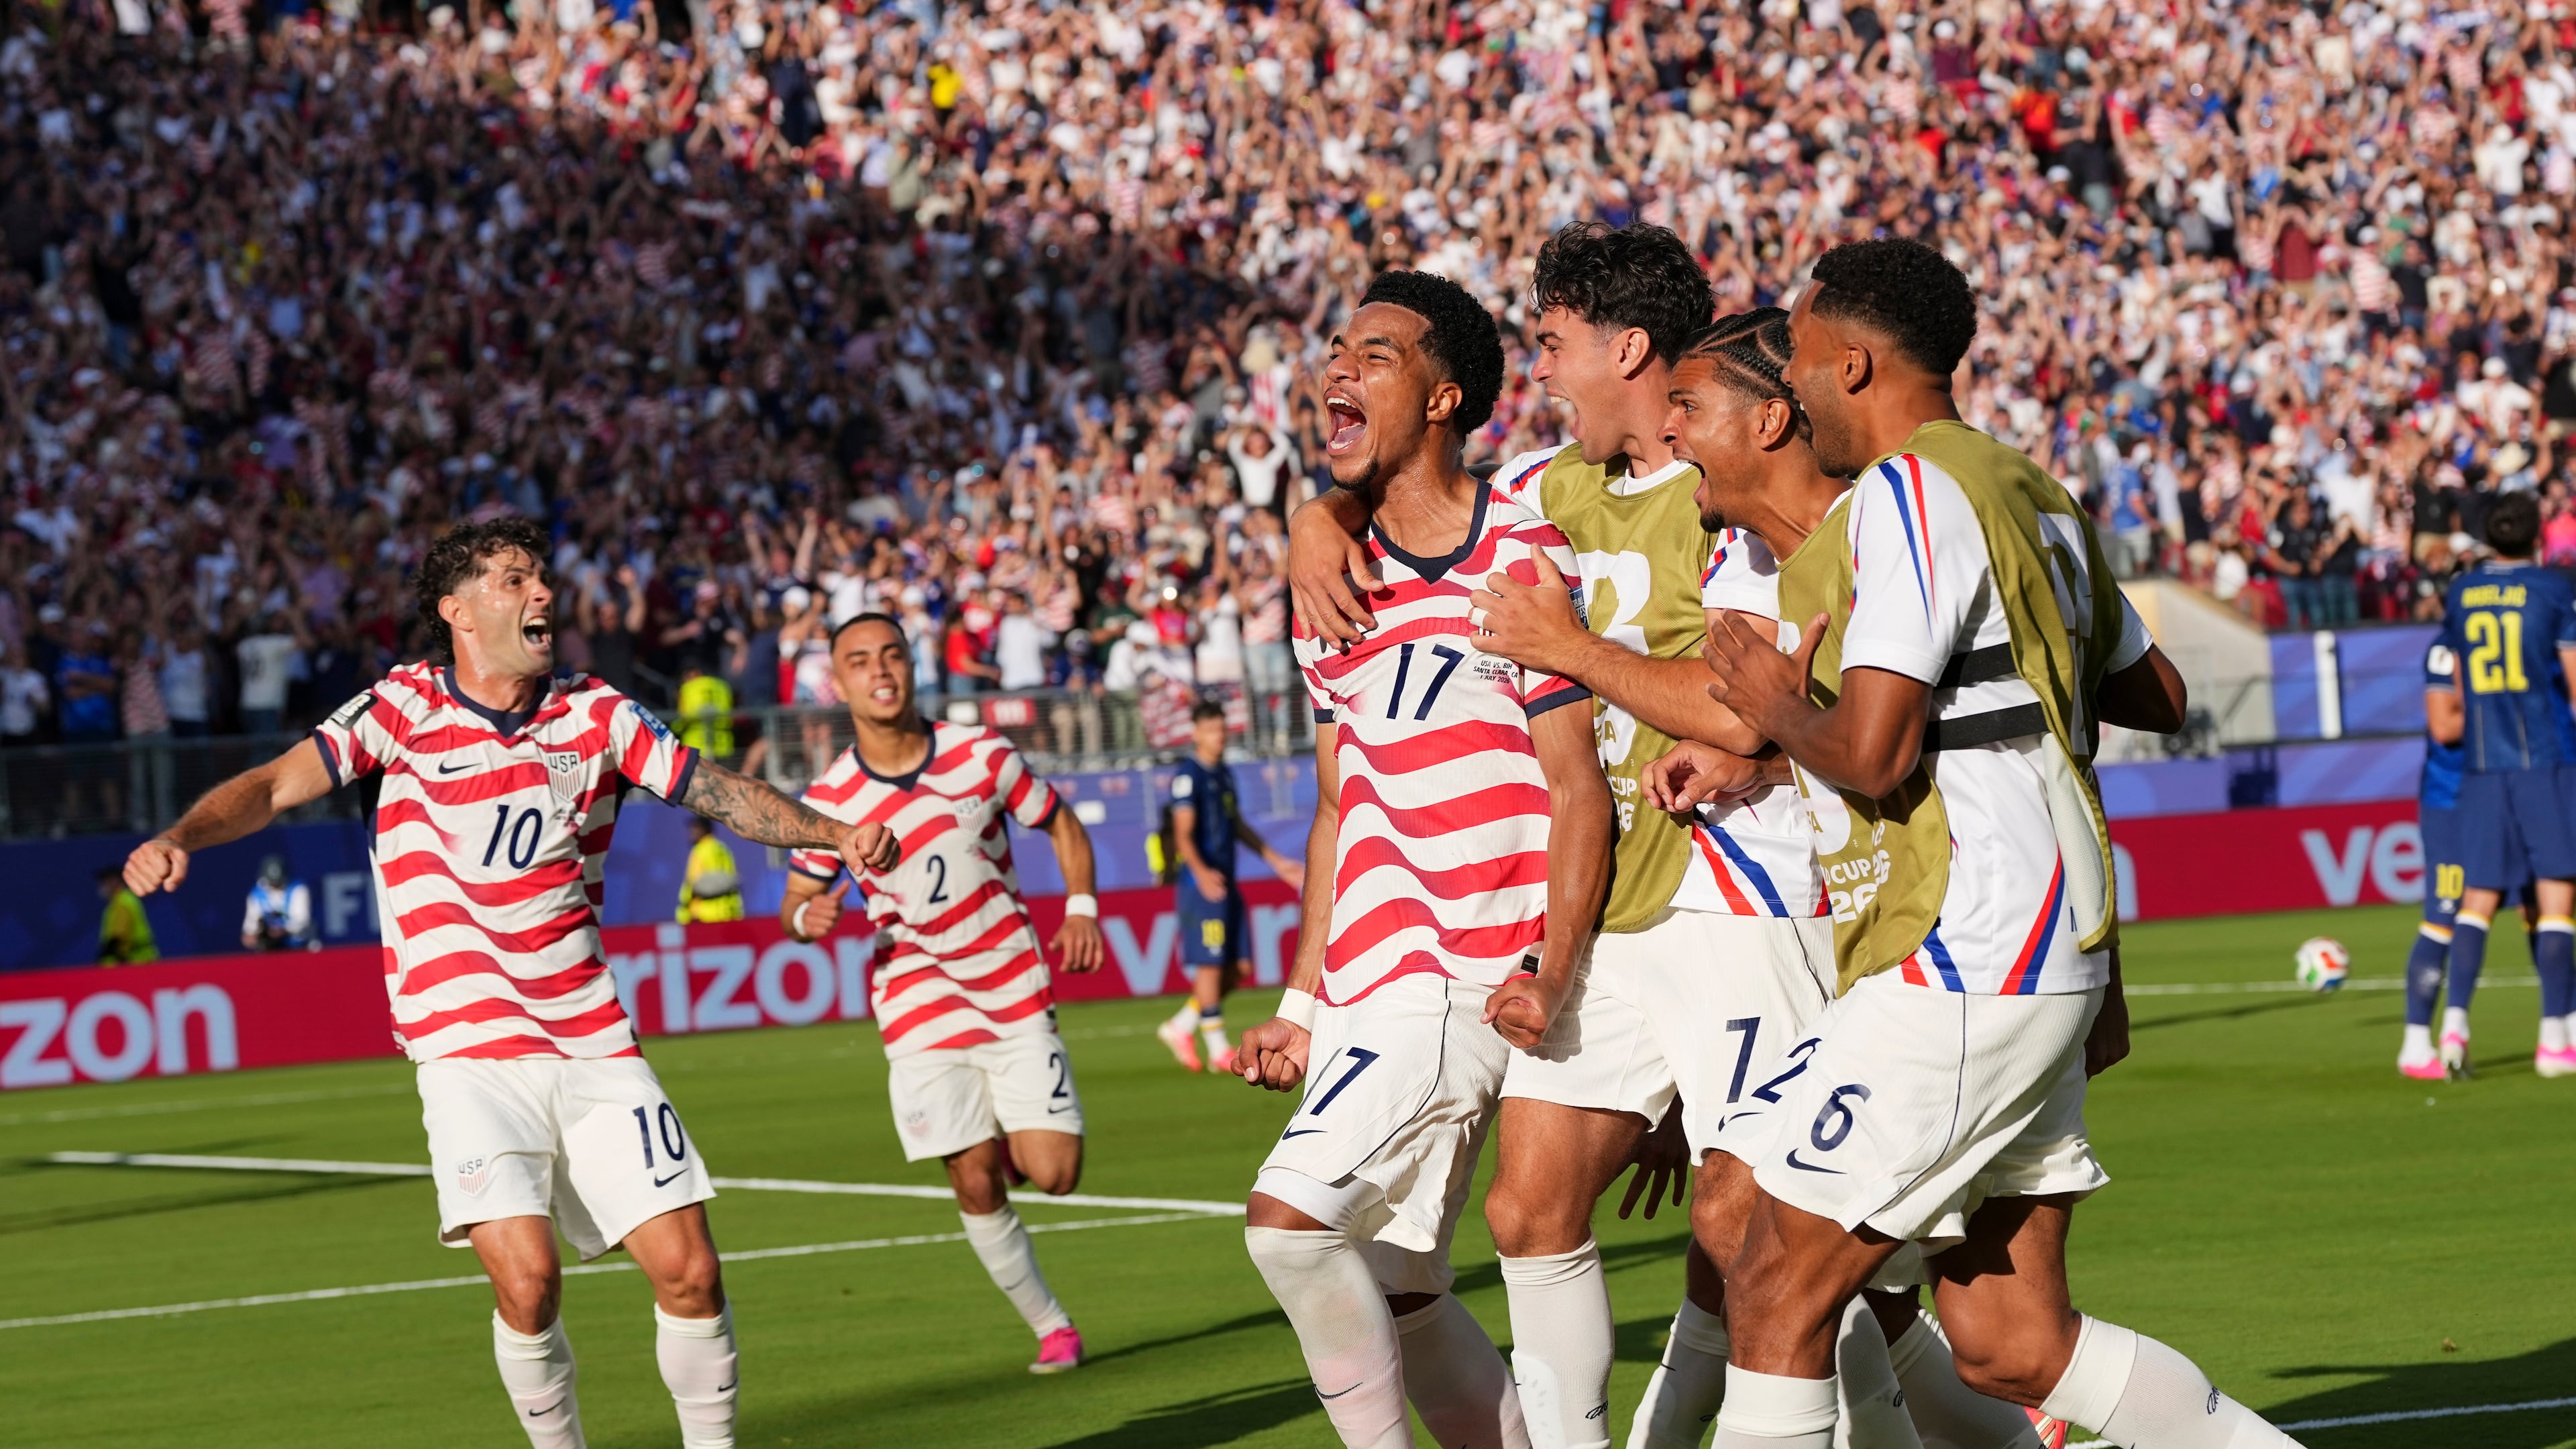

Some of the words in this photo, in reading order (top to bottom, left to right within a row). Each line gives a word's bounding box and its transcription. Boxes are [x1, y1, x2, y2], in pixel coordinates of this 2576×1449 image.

[1473, 666, 1490, 674] SANTA
[2465, 611, 2528, 694] 21
[1386, 643, 1465, 721] 17
[549, 755, 577, 773] USA
[1611, 775, 1637, 797] CUP
[482, 804, 543, 870] 10
[927, 855, 949, 904] 2
[1830, 859, 1872, 883] CUP
[2435, 863, 2465, 900] 10
[1829, 883, 1878, 924] 26
[0, 983, 238, 1089] zon
[1726, 1016, 1761, 1104] 7
[1049, 1053, 1069, 1098] 2
[1294, 1046, 1381, 1116] 17
[1751, 1037, 1823, 1104] 2
[632, 1102, 685, 1169] 10
[1811, 1083, 1872, 1152] 6
[458, 1159, 482, 1175] USA
